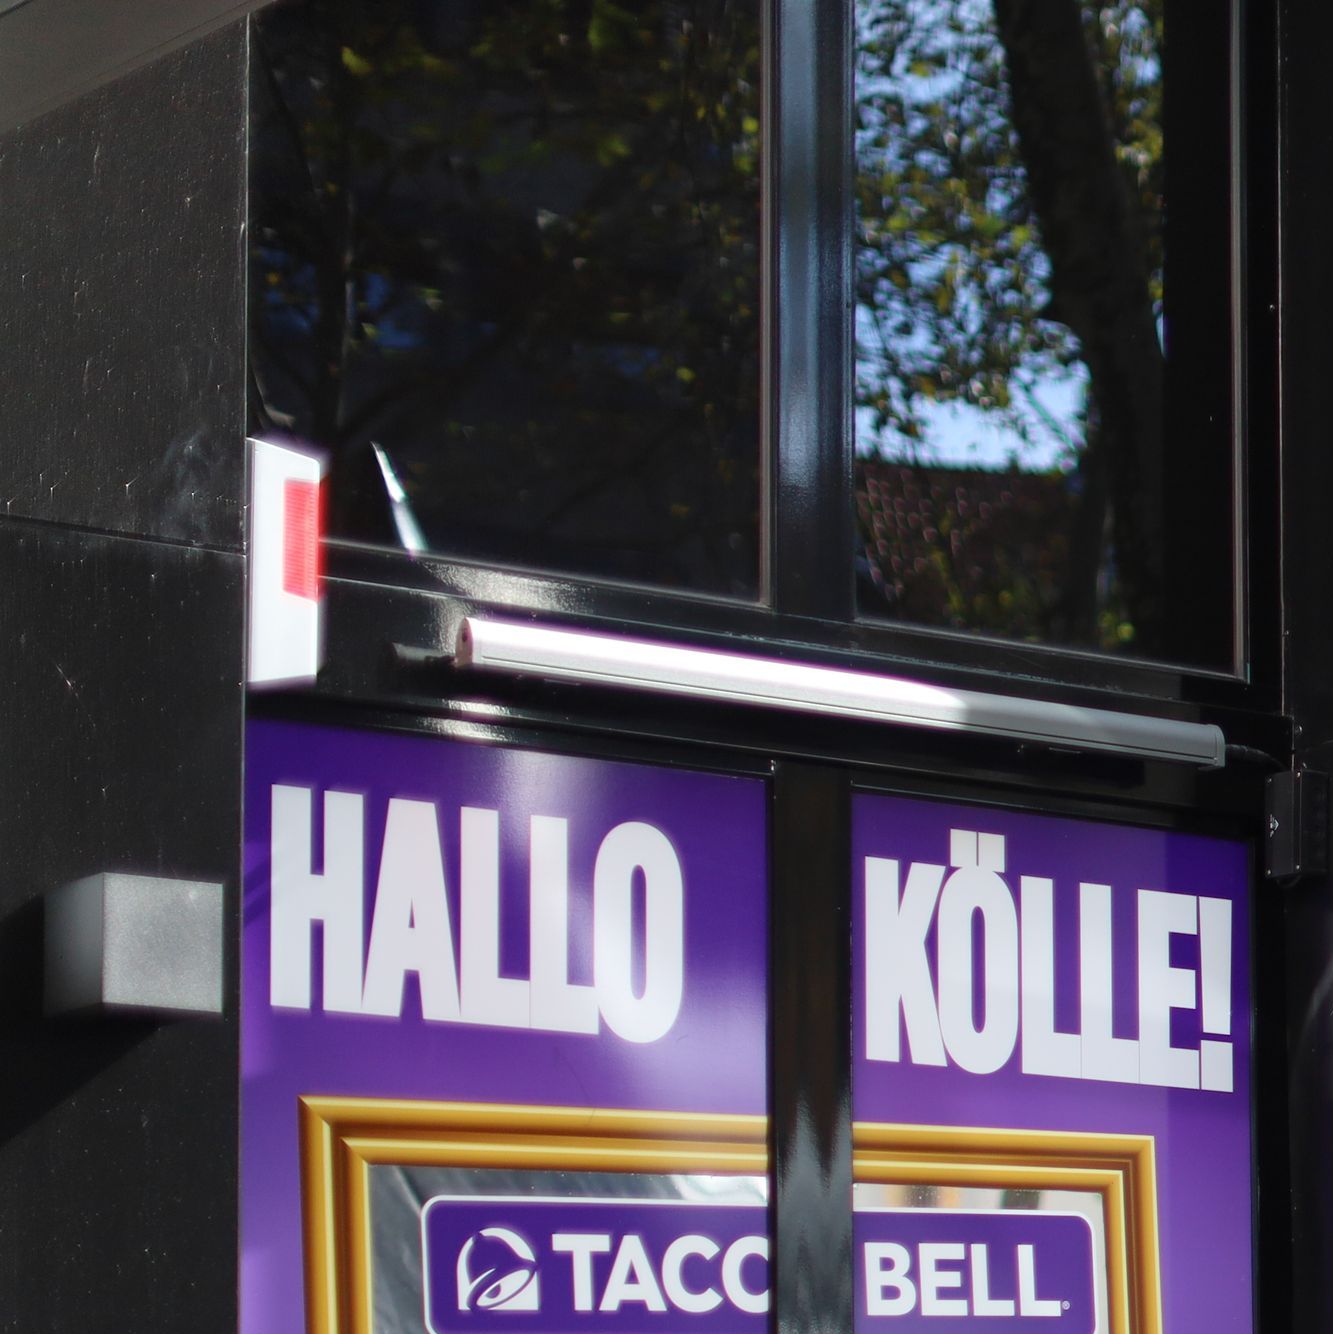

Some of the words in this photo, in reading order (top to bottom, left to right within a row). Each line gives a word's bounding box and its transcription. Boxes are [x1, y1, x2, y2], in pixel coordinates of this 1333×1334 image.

[270, 783, 683, 1044] HALLO
[864, 828, 1233, 1093] KÖLLE!
[865, 1243, 1063, 1318] BELL
